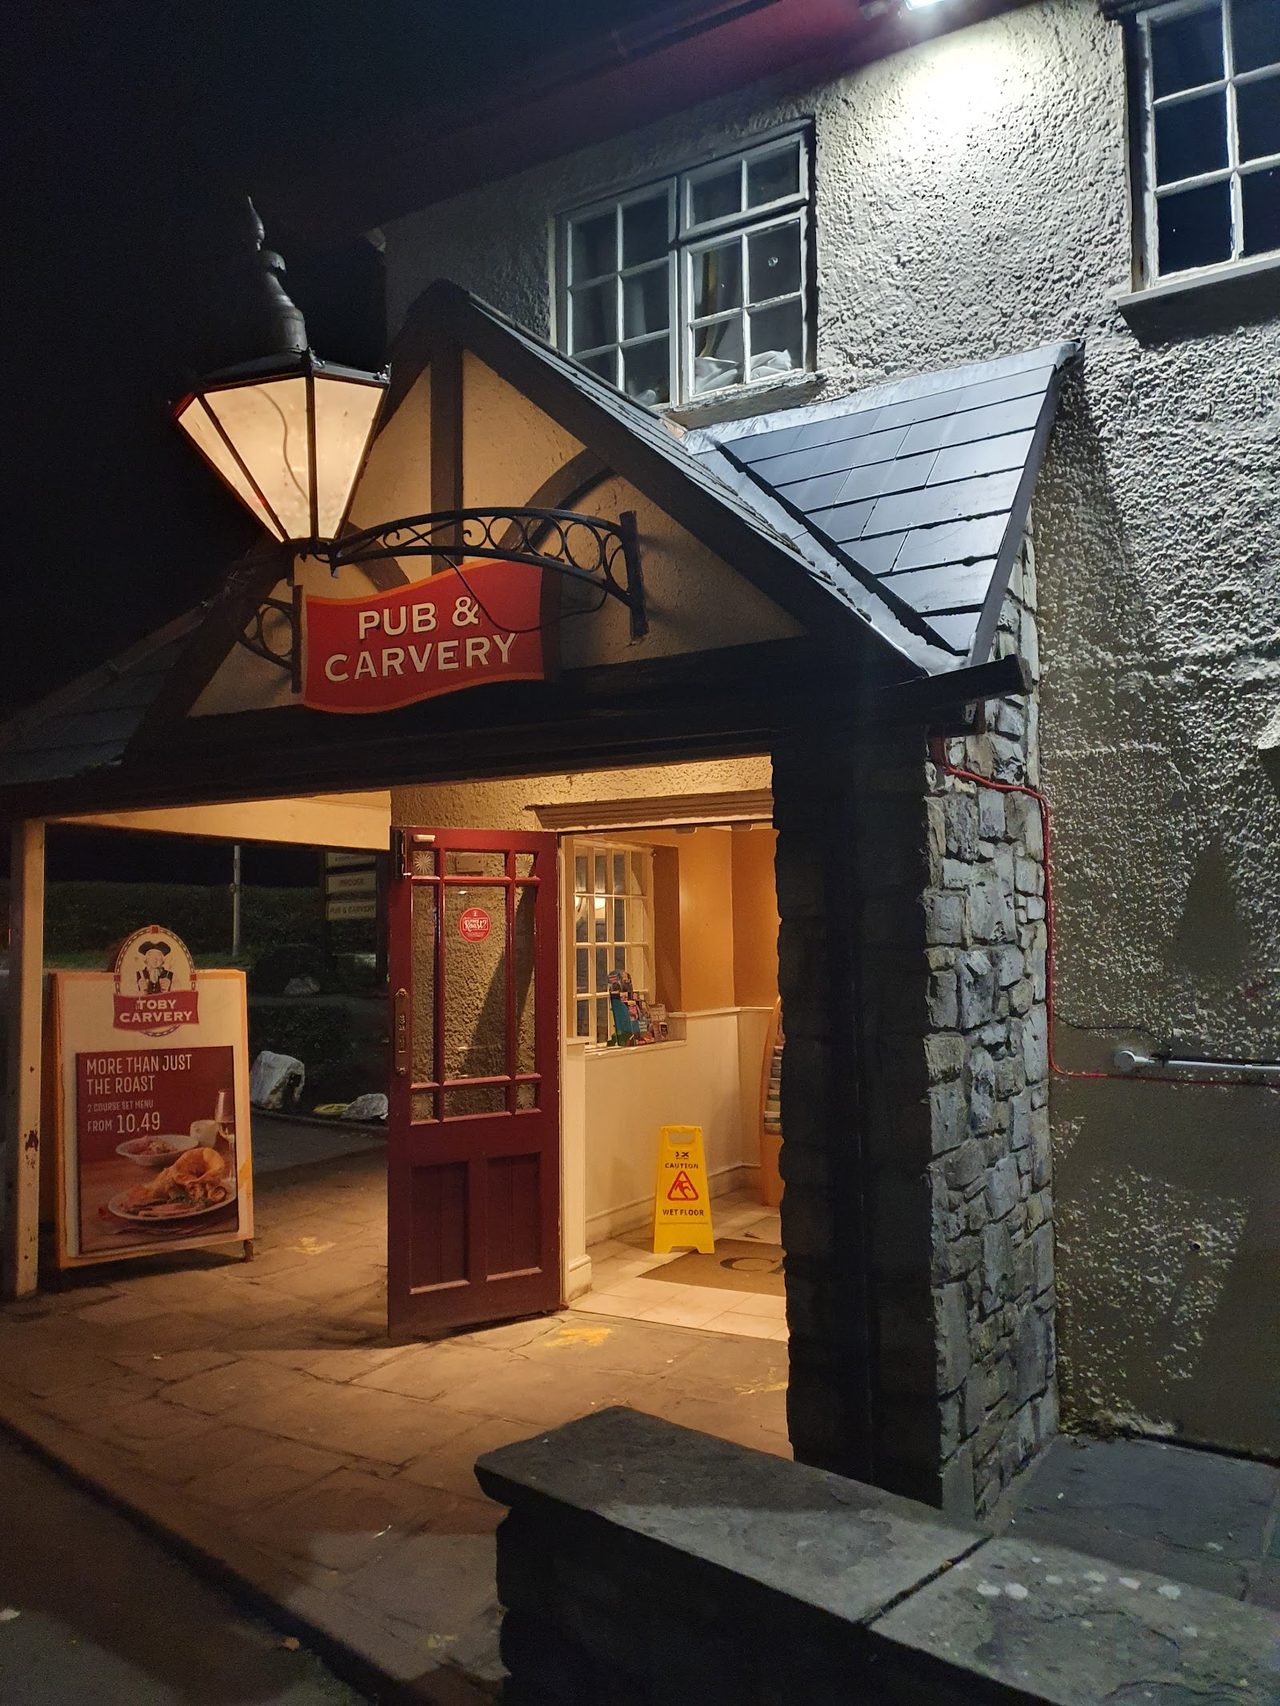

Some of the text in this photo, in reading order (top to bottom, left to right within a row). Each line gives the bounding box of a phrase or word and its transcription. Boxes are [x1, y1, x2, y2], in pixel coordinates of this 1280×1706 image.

[358, 596, 479, 640] PUB &
[324, 632, 518, 682] CARVERY
[136, 999, 176, 1010] TOBY
[119, 1011, 193, 1023] CARVERY
[86, 1054, 192, 1075] MORE THAN JUST
[86, 1075, 155, 1095] THE ROAST
[87, 1099, 154, 1113] 2 COURSE SET MENU
[87, 1111, 160, 1133] FROM 10.49
[662, 1208, 678, 1216] WET
